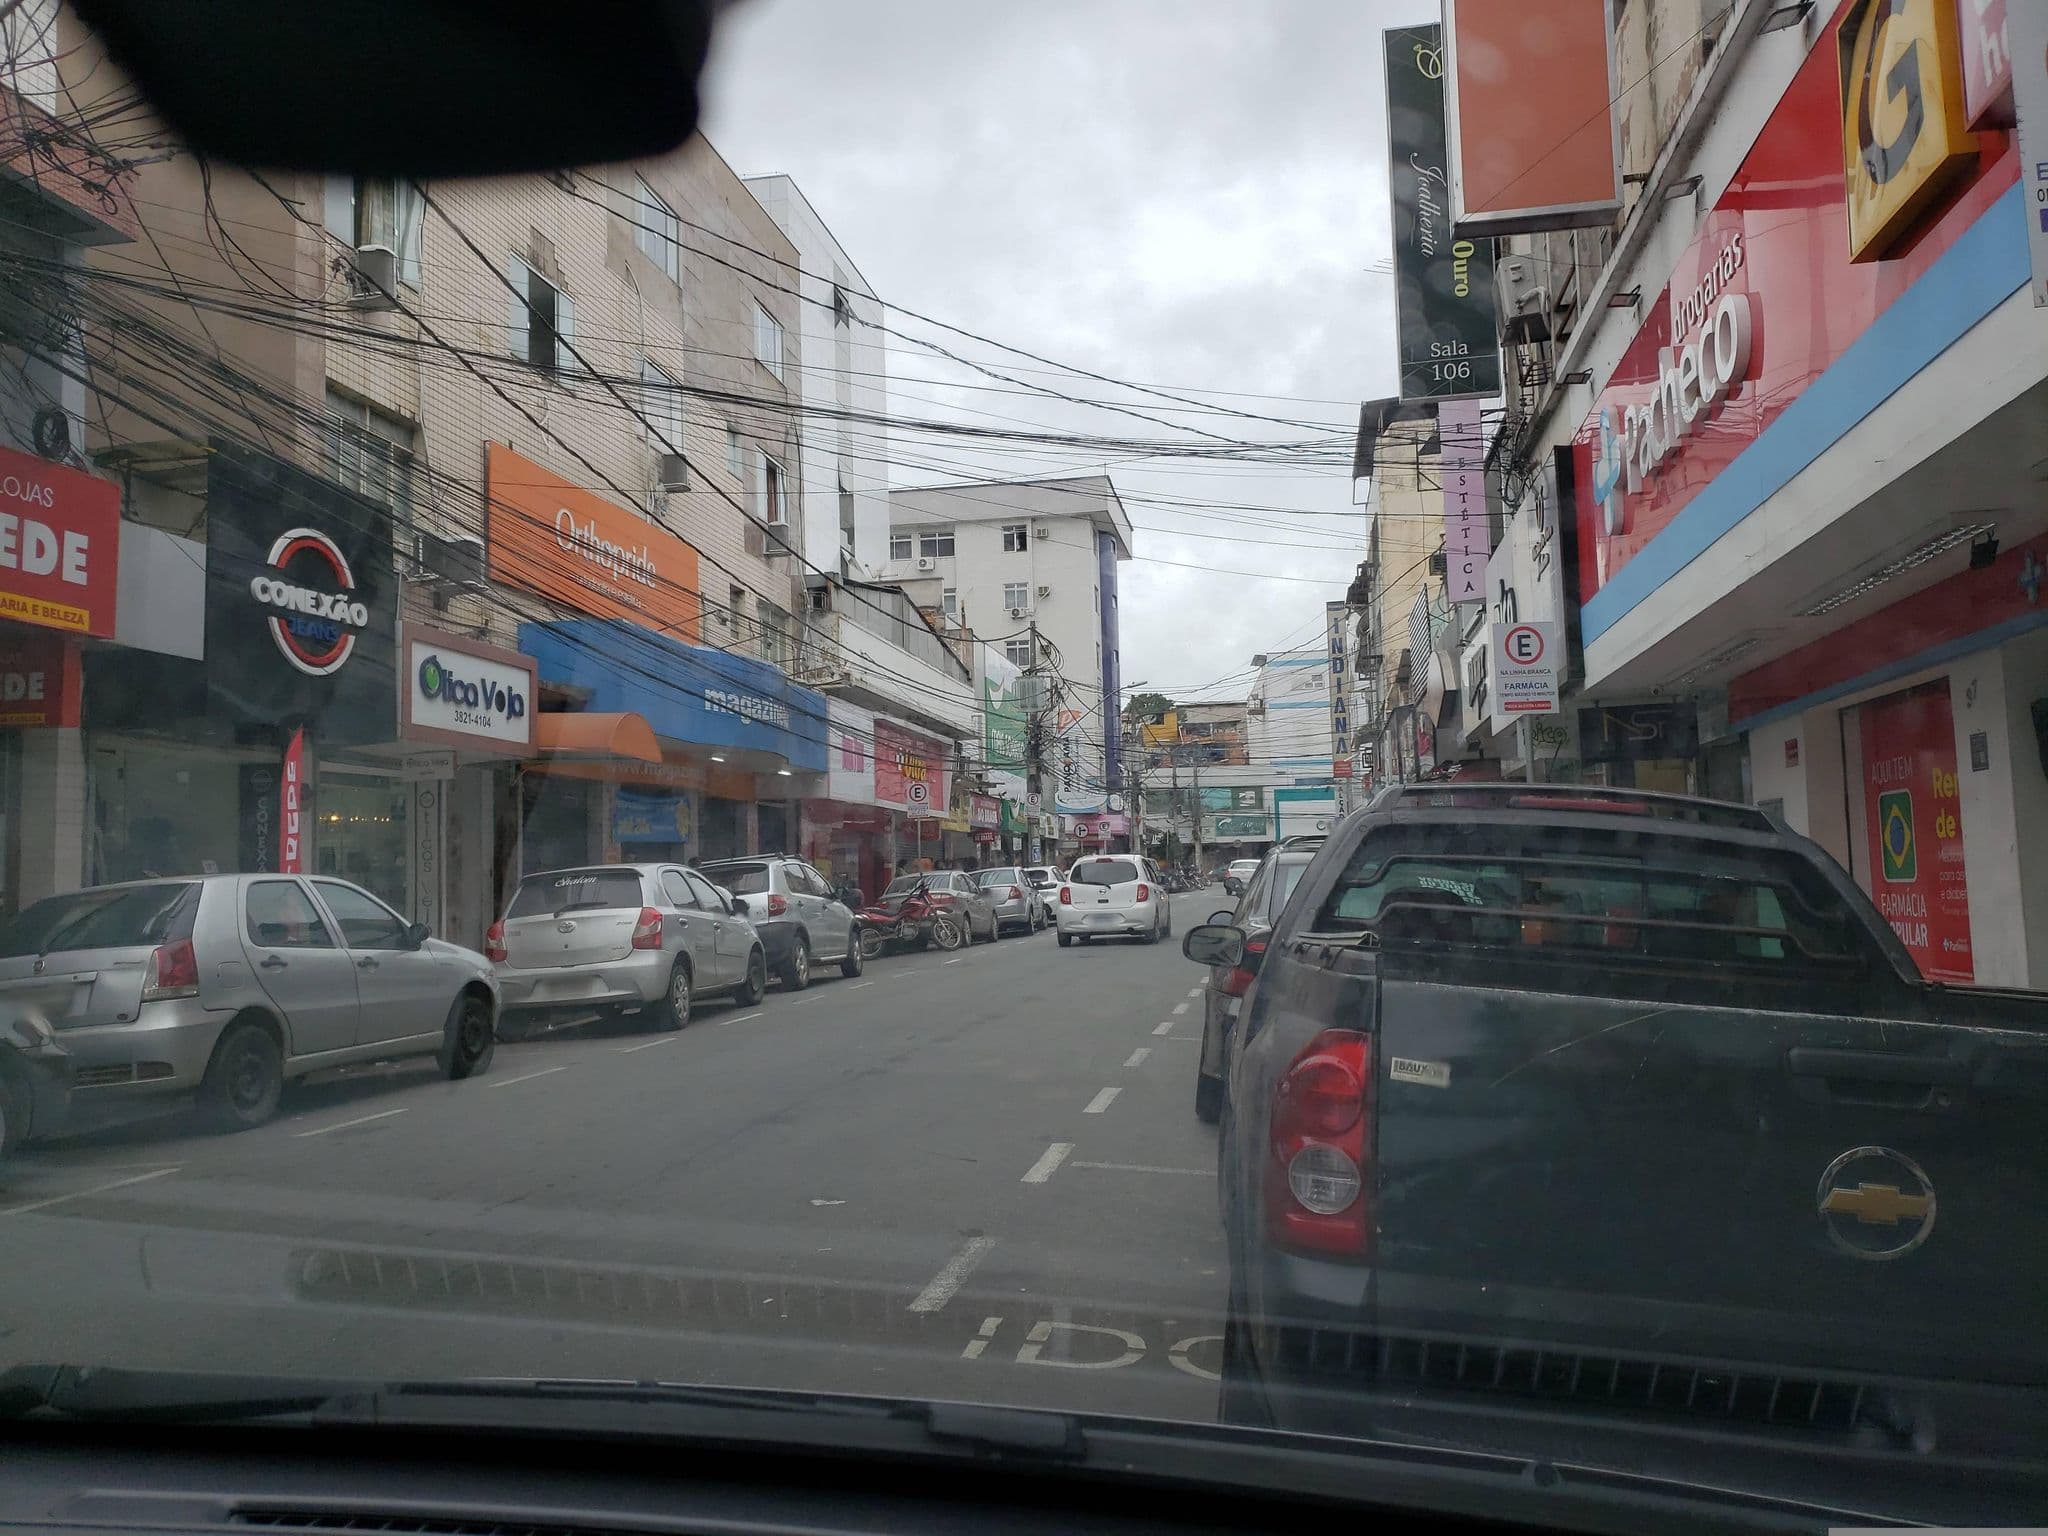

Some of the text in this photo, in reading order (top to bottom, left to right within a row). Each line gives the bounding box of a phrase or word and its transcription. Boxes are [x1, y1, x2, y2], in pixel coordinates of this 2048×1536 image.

[1409, 151, 1448, 259] Joalheria
[1453, 240, 1475, 297] Ouro
[1674, 233, 1746, 343] drogarias
[1430, 341, 1469, 358] Sala
[1431, 362, 1471, 382] 106
[1624, 293, 1752, 496] Pacheco
[0, 475, 55, 509] OJAS
[1458, 456, 1475, 593] ESTÉTICA
[555, 508, 657, 589] Orthopride
[32, 603, 39, 616] E
[42, 606, 86, 627] BELEZA
[250, 576, 369, 628] CONEXÃO
[288, 615, 337, 641] JEANS
[1517, 634, 1532, 657] E
[0, 671, 45, 701] DE
[480, 678, 525, 721] Voja
[1331, 617, 1349, 755] INDIANA
[454, 709, 492, 729] 3821-4104
[914, 787, 922, 799] E
[1935, 807, 1956, 838] de
[1880, 887, 1928, 918] FARMÁCIA
